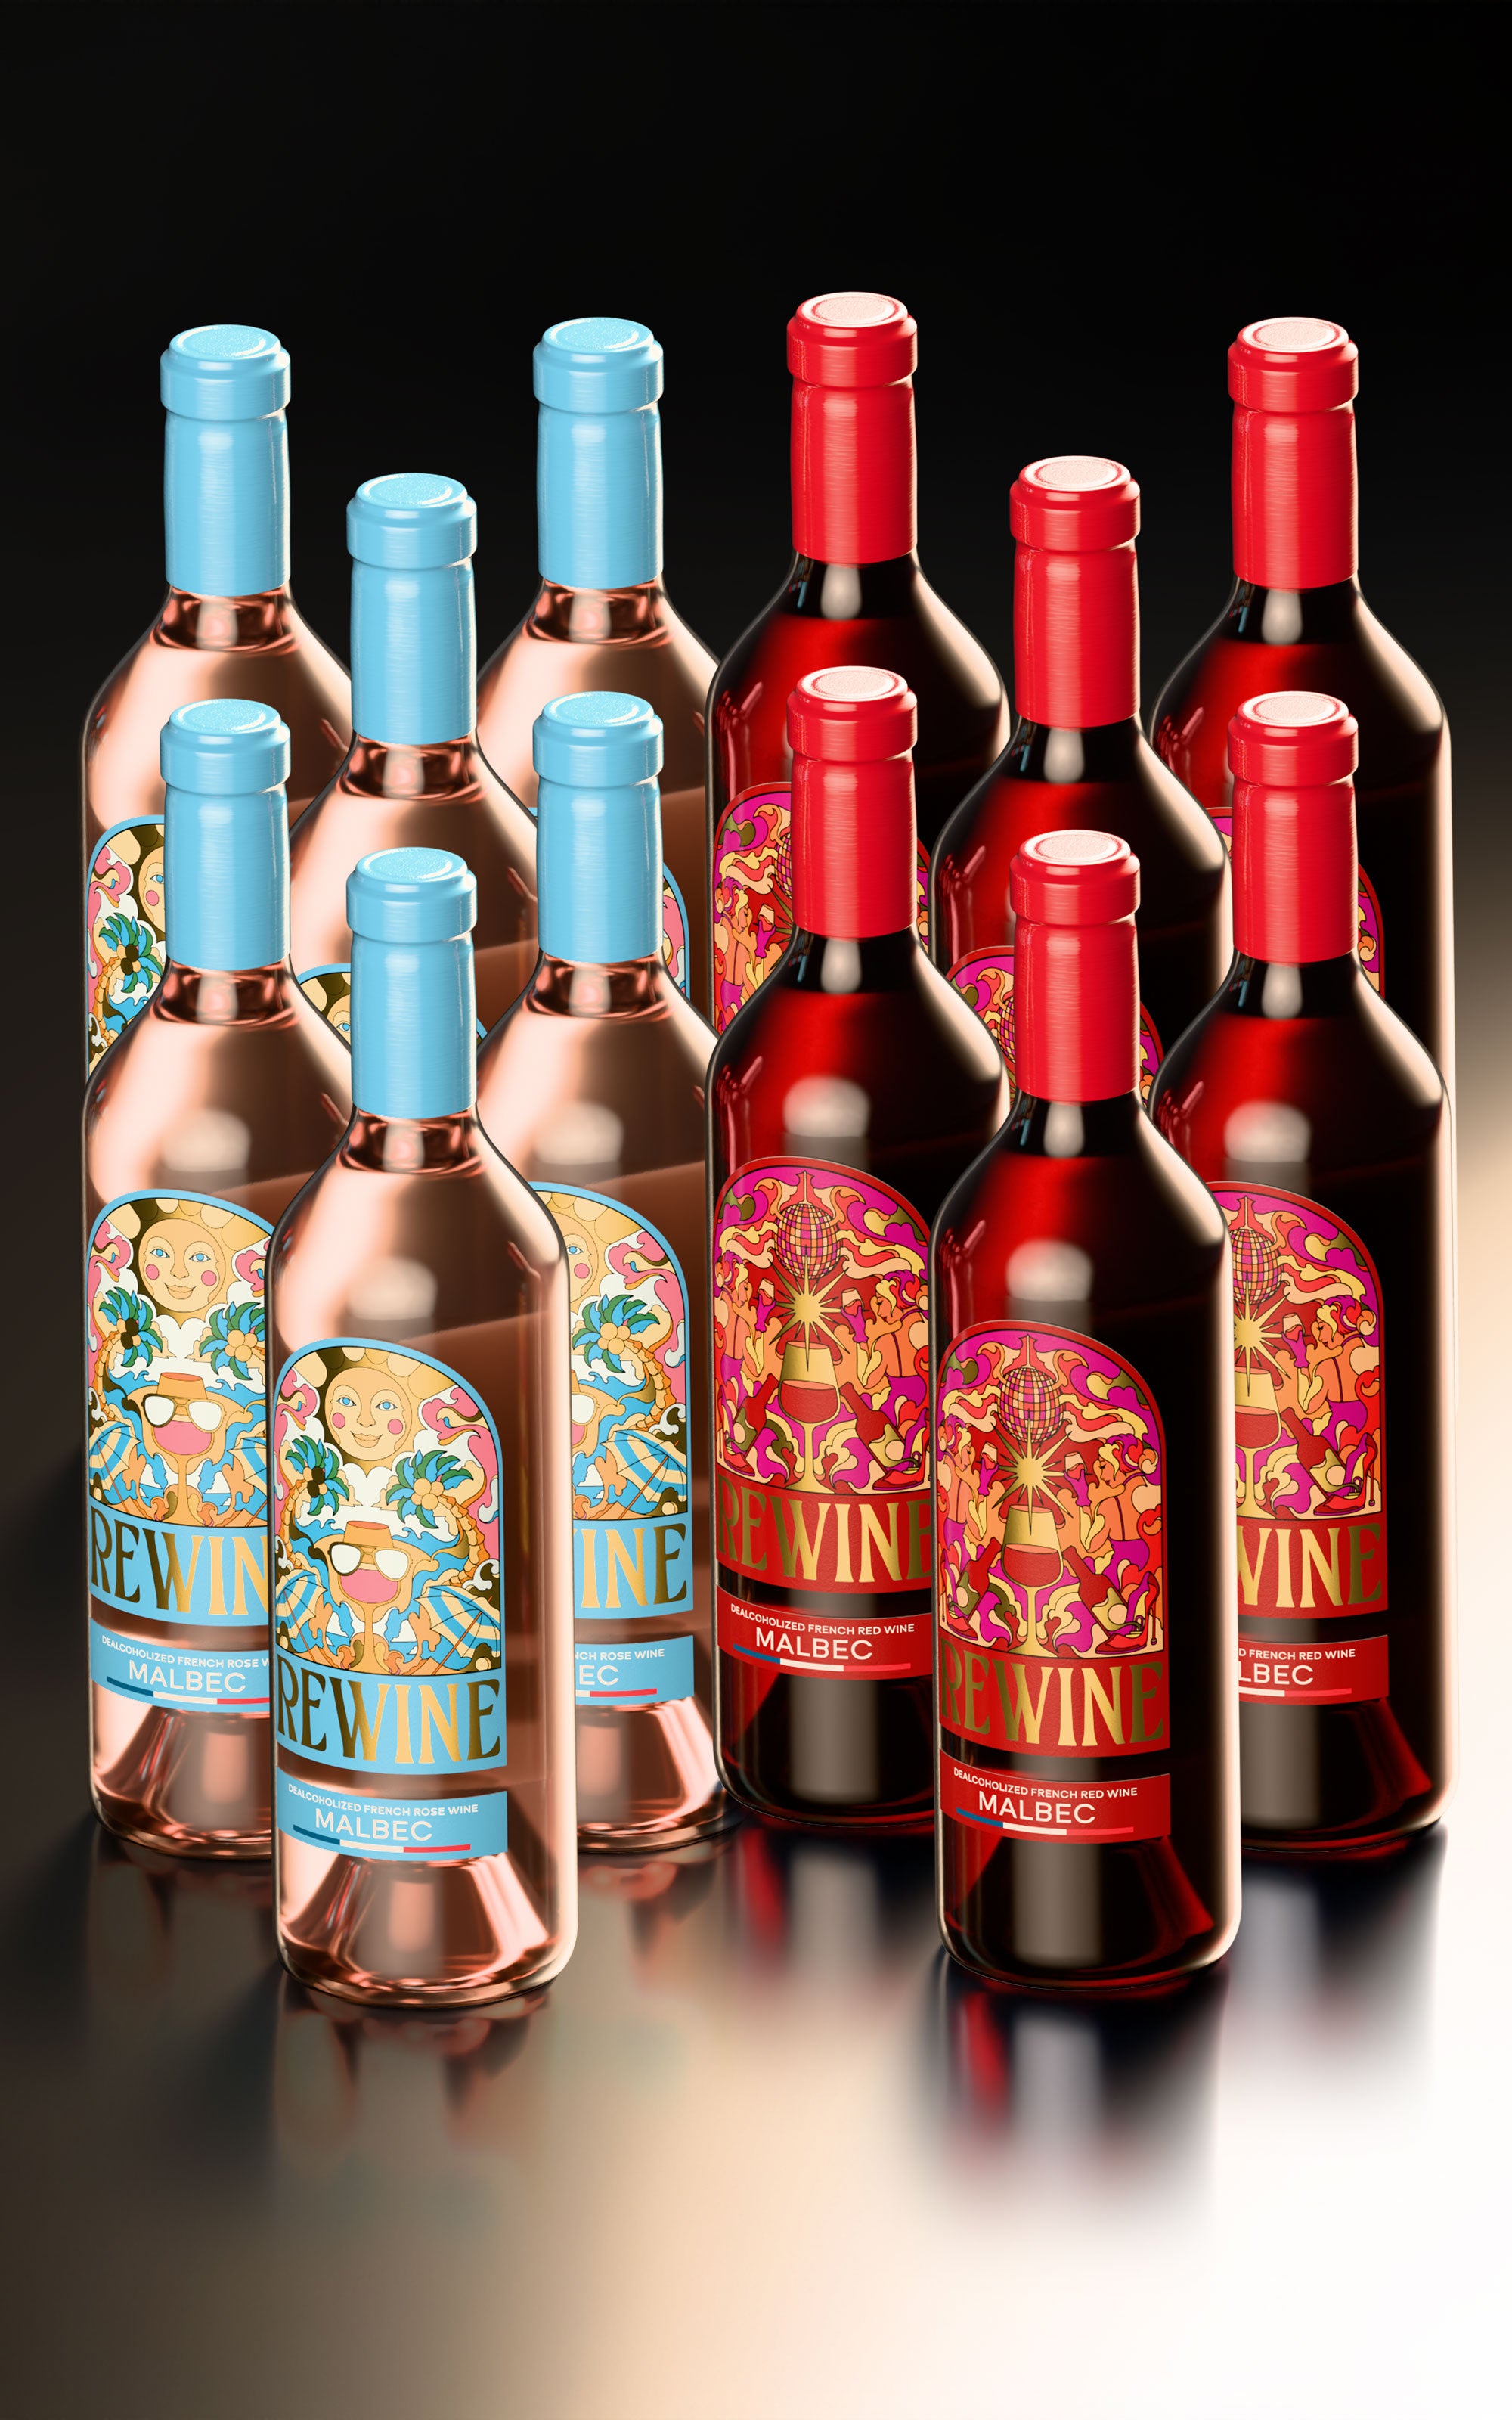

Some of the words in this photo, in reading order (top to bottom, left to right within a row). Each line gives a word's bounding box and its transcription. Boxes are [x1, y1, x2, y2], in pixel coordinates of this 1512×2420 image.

[718, 1473, 931, 1583] REWINE
[574, 1523, 687, 1609] INE
[731, 1603, 806, 1632] DEALCOHOLIZED
[808, 1624, 855, 1635] FRENCH
[858, 1626, 881, 1635] RED
[884, 1624, 915, 1634] WINE
[102, 1635, 175, 1664] DEALCOHOLIZED
[177, 1656, 224, 1668] FRENCH
[228, 1658, 259, 1668] ROSE
[600, 1652, 632, 1661] ROSE
[634, 1649, 665, 1659] WINE
[756, 1627, 872, 1660] MALBEC
[1249, 1649, 1296, 1661] FRENCH
[1299, 1651, 1322, 1660] RED
[1325, 1649, 1356, 1659] WINE
[129, 1660, 246, 1693] MALBEC
[940, 1637, 1163, 1747] REWINE
[277, 1653, 500, 1764] REWINE
[288, 1783, 361, 1812] DEALCOHOLIZED
[364, 1804, 411, 1816] FRENCH
[414, 1807, 445, 1816] ROSE
[448, 1804, 479, 1815] WINE
[953, 1767, 1028, 1795] DEALCOHOLIZED
[1031, 1788, 1077, 1799] FRENCH
[1081, 1790, 1104, 1799] RED
[1107, 1787, 1138, 1798] WINE
[979, 1791, 1095, 1824] MALBEC
[315, 1808, 432, 1841] MALBEC
